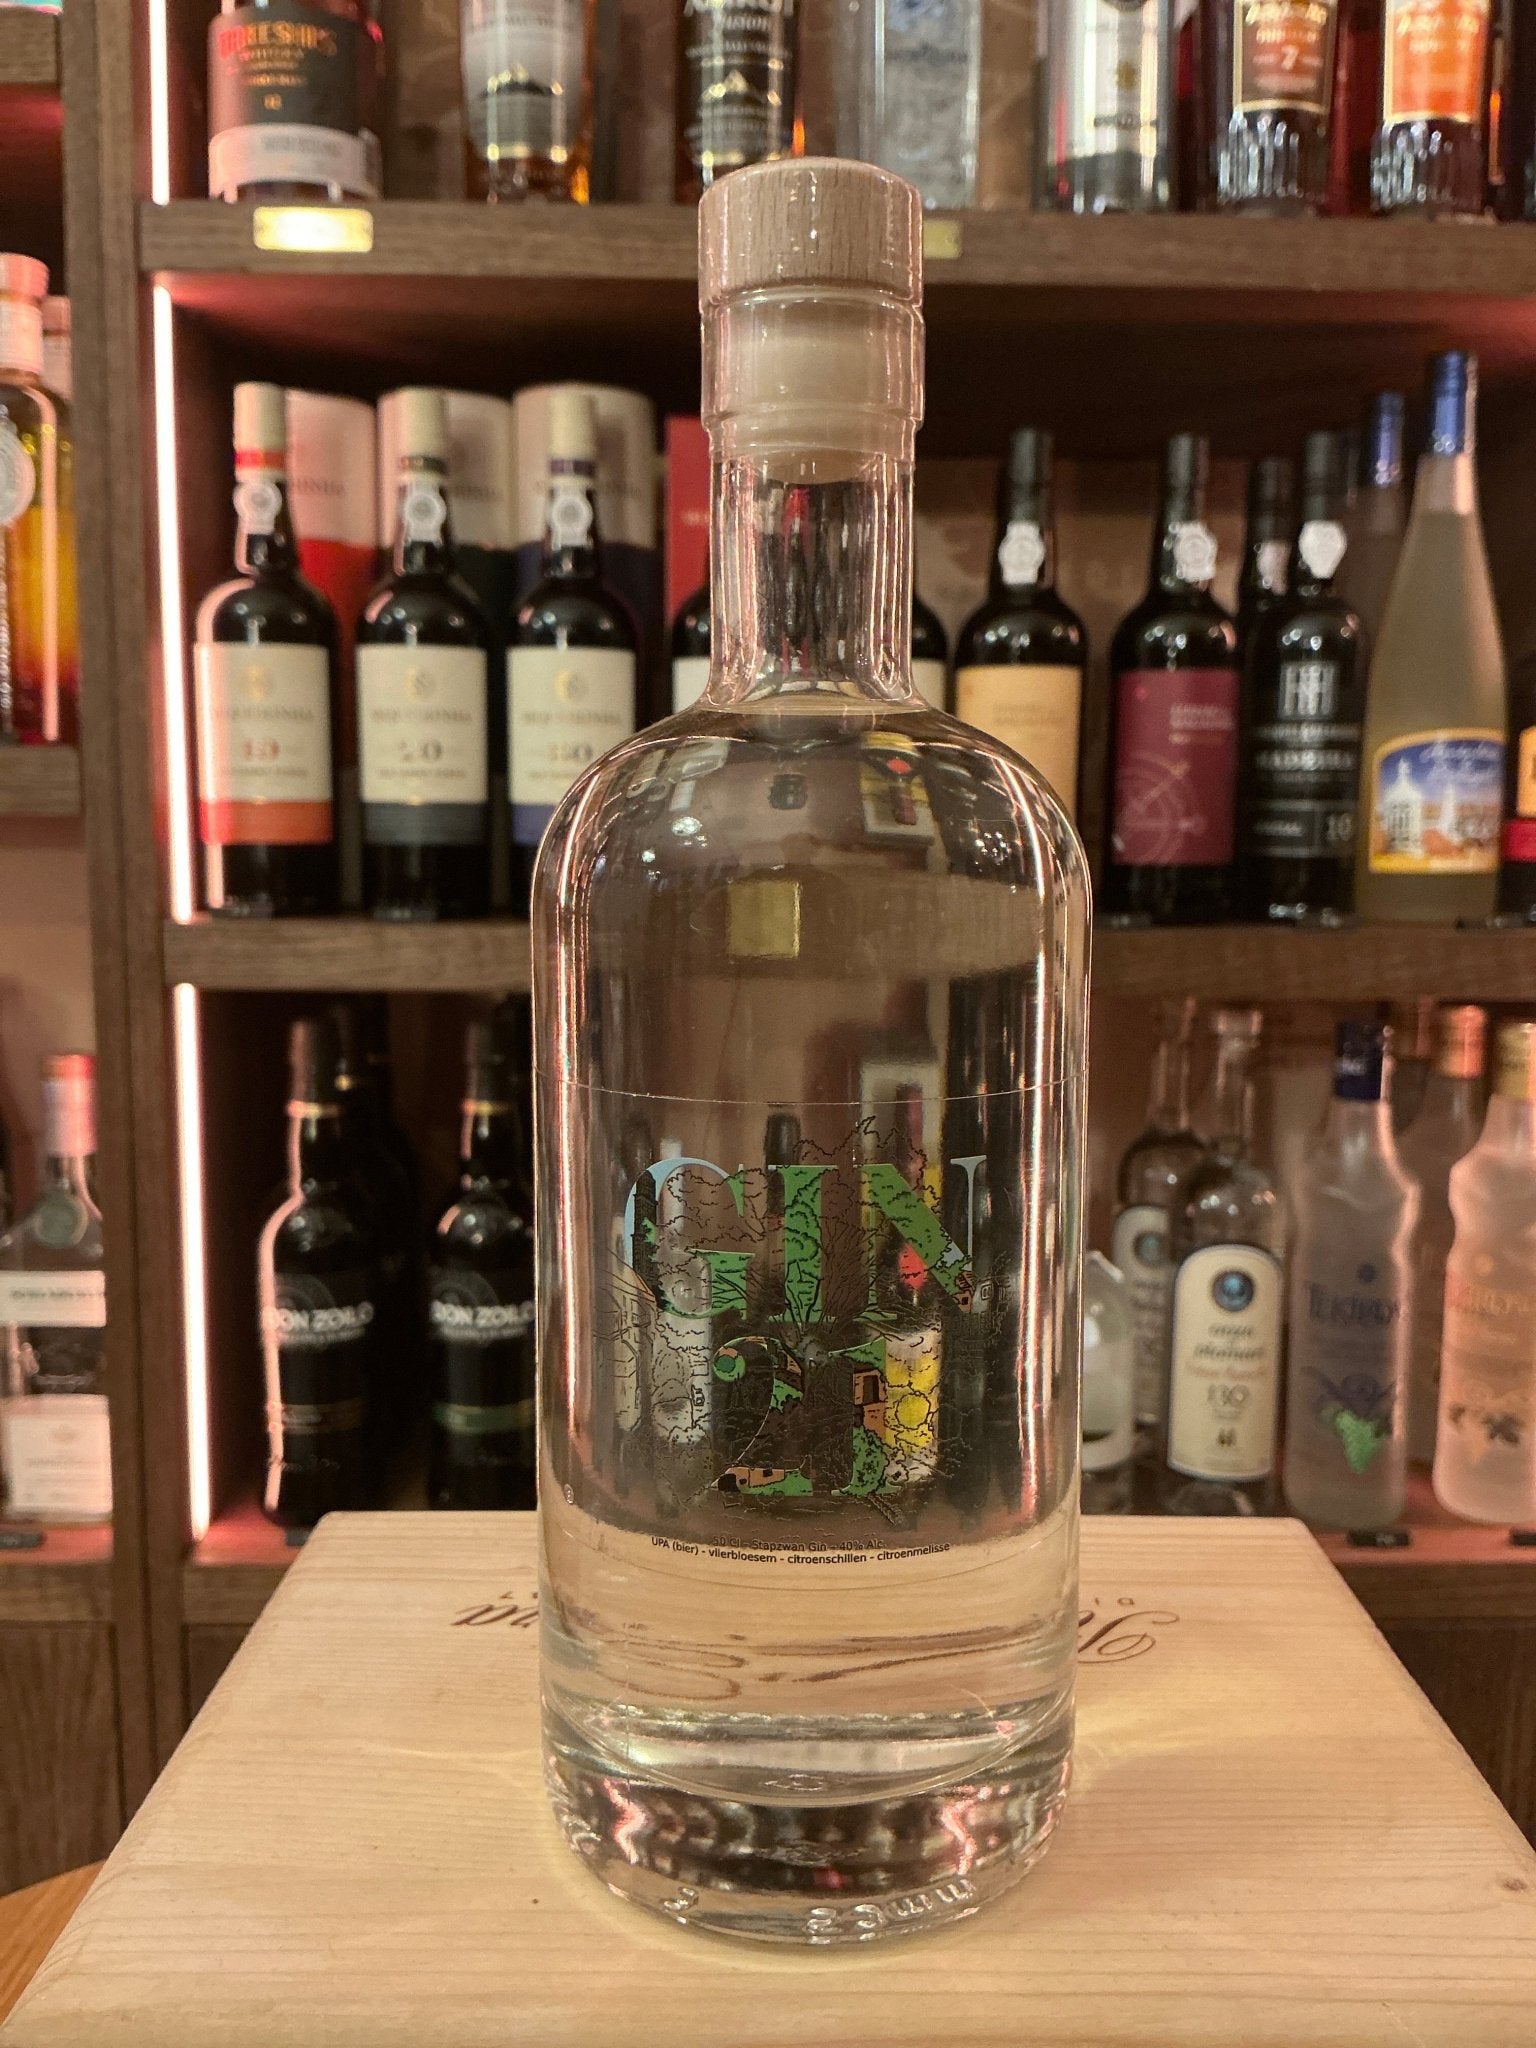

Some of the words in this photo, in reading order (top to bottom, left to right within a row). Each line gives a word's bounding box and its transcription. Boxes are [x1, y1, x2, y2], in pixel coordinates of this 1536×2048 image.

[624, 1155, 987, 1322] GIN
[710, 1336, 902, 1498] 21
[651, 1536, 670, 1549] UPA
[672, 1540, 699, 1556] (bier)
[708, 1547, 777, 1563] vlierbloesem
[787, 1553, 867, 1564] citroenschillen
[877, 1542, 951, 1561] citroenmelisse
[713, 1536, 727, 1547] 50
[751, 1539, 805, 1552] Stapzwan
[808, 1541, 827, 1552] Gin
[839, 1540, 863, 1551] 40%
